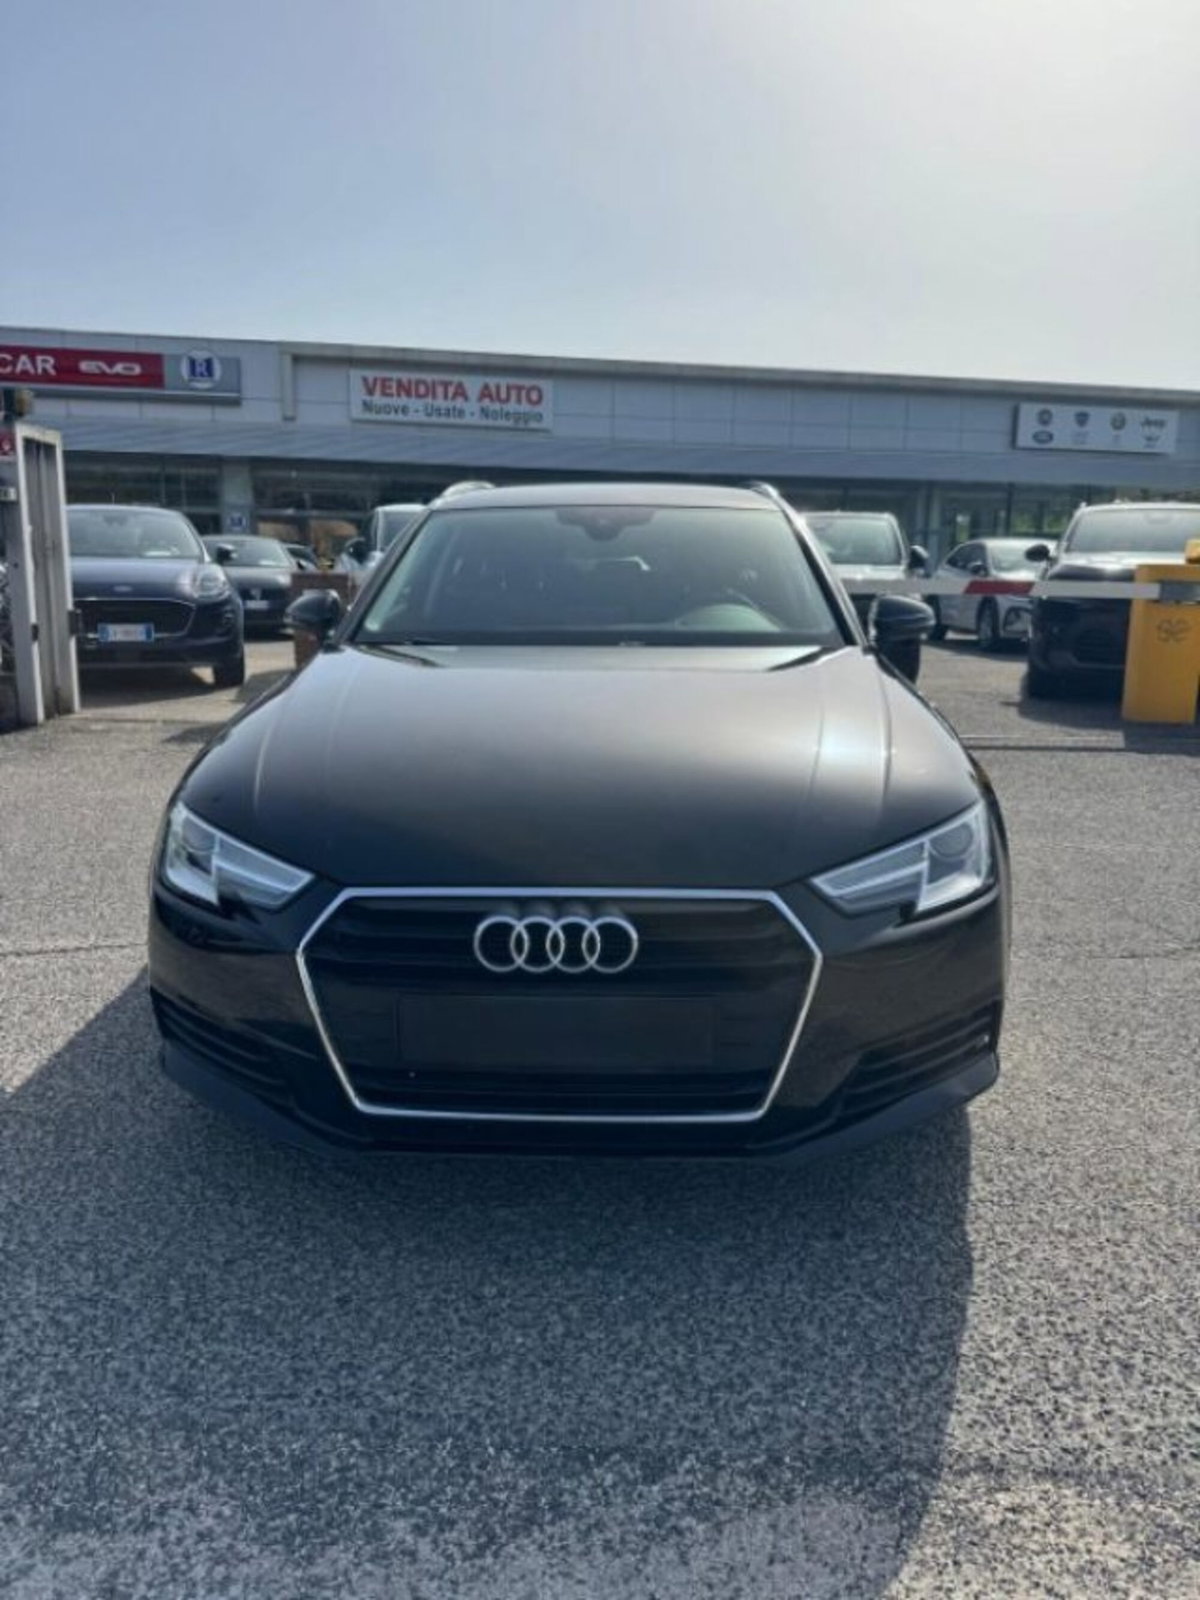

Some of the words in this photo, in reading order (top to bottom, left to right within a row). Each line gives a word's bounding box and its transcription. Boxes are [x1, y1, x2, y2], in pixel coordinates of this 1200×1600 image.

[78, 360, 142, 376] EVO
[361, 376, 469, 401] VENDITA
[478, 382, 544, 406] AUTO
[362, 400, 409, 416] Nuove
[424, 404, 466, 419] Usate
[479, 406, 544, 426] Noleggio
